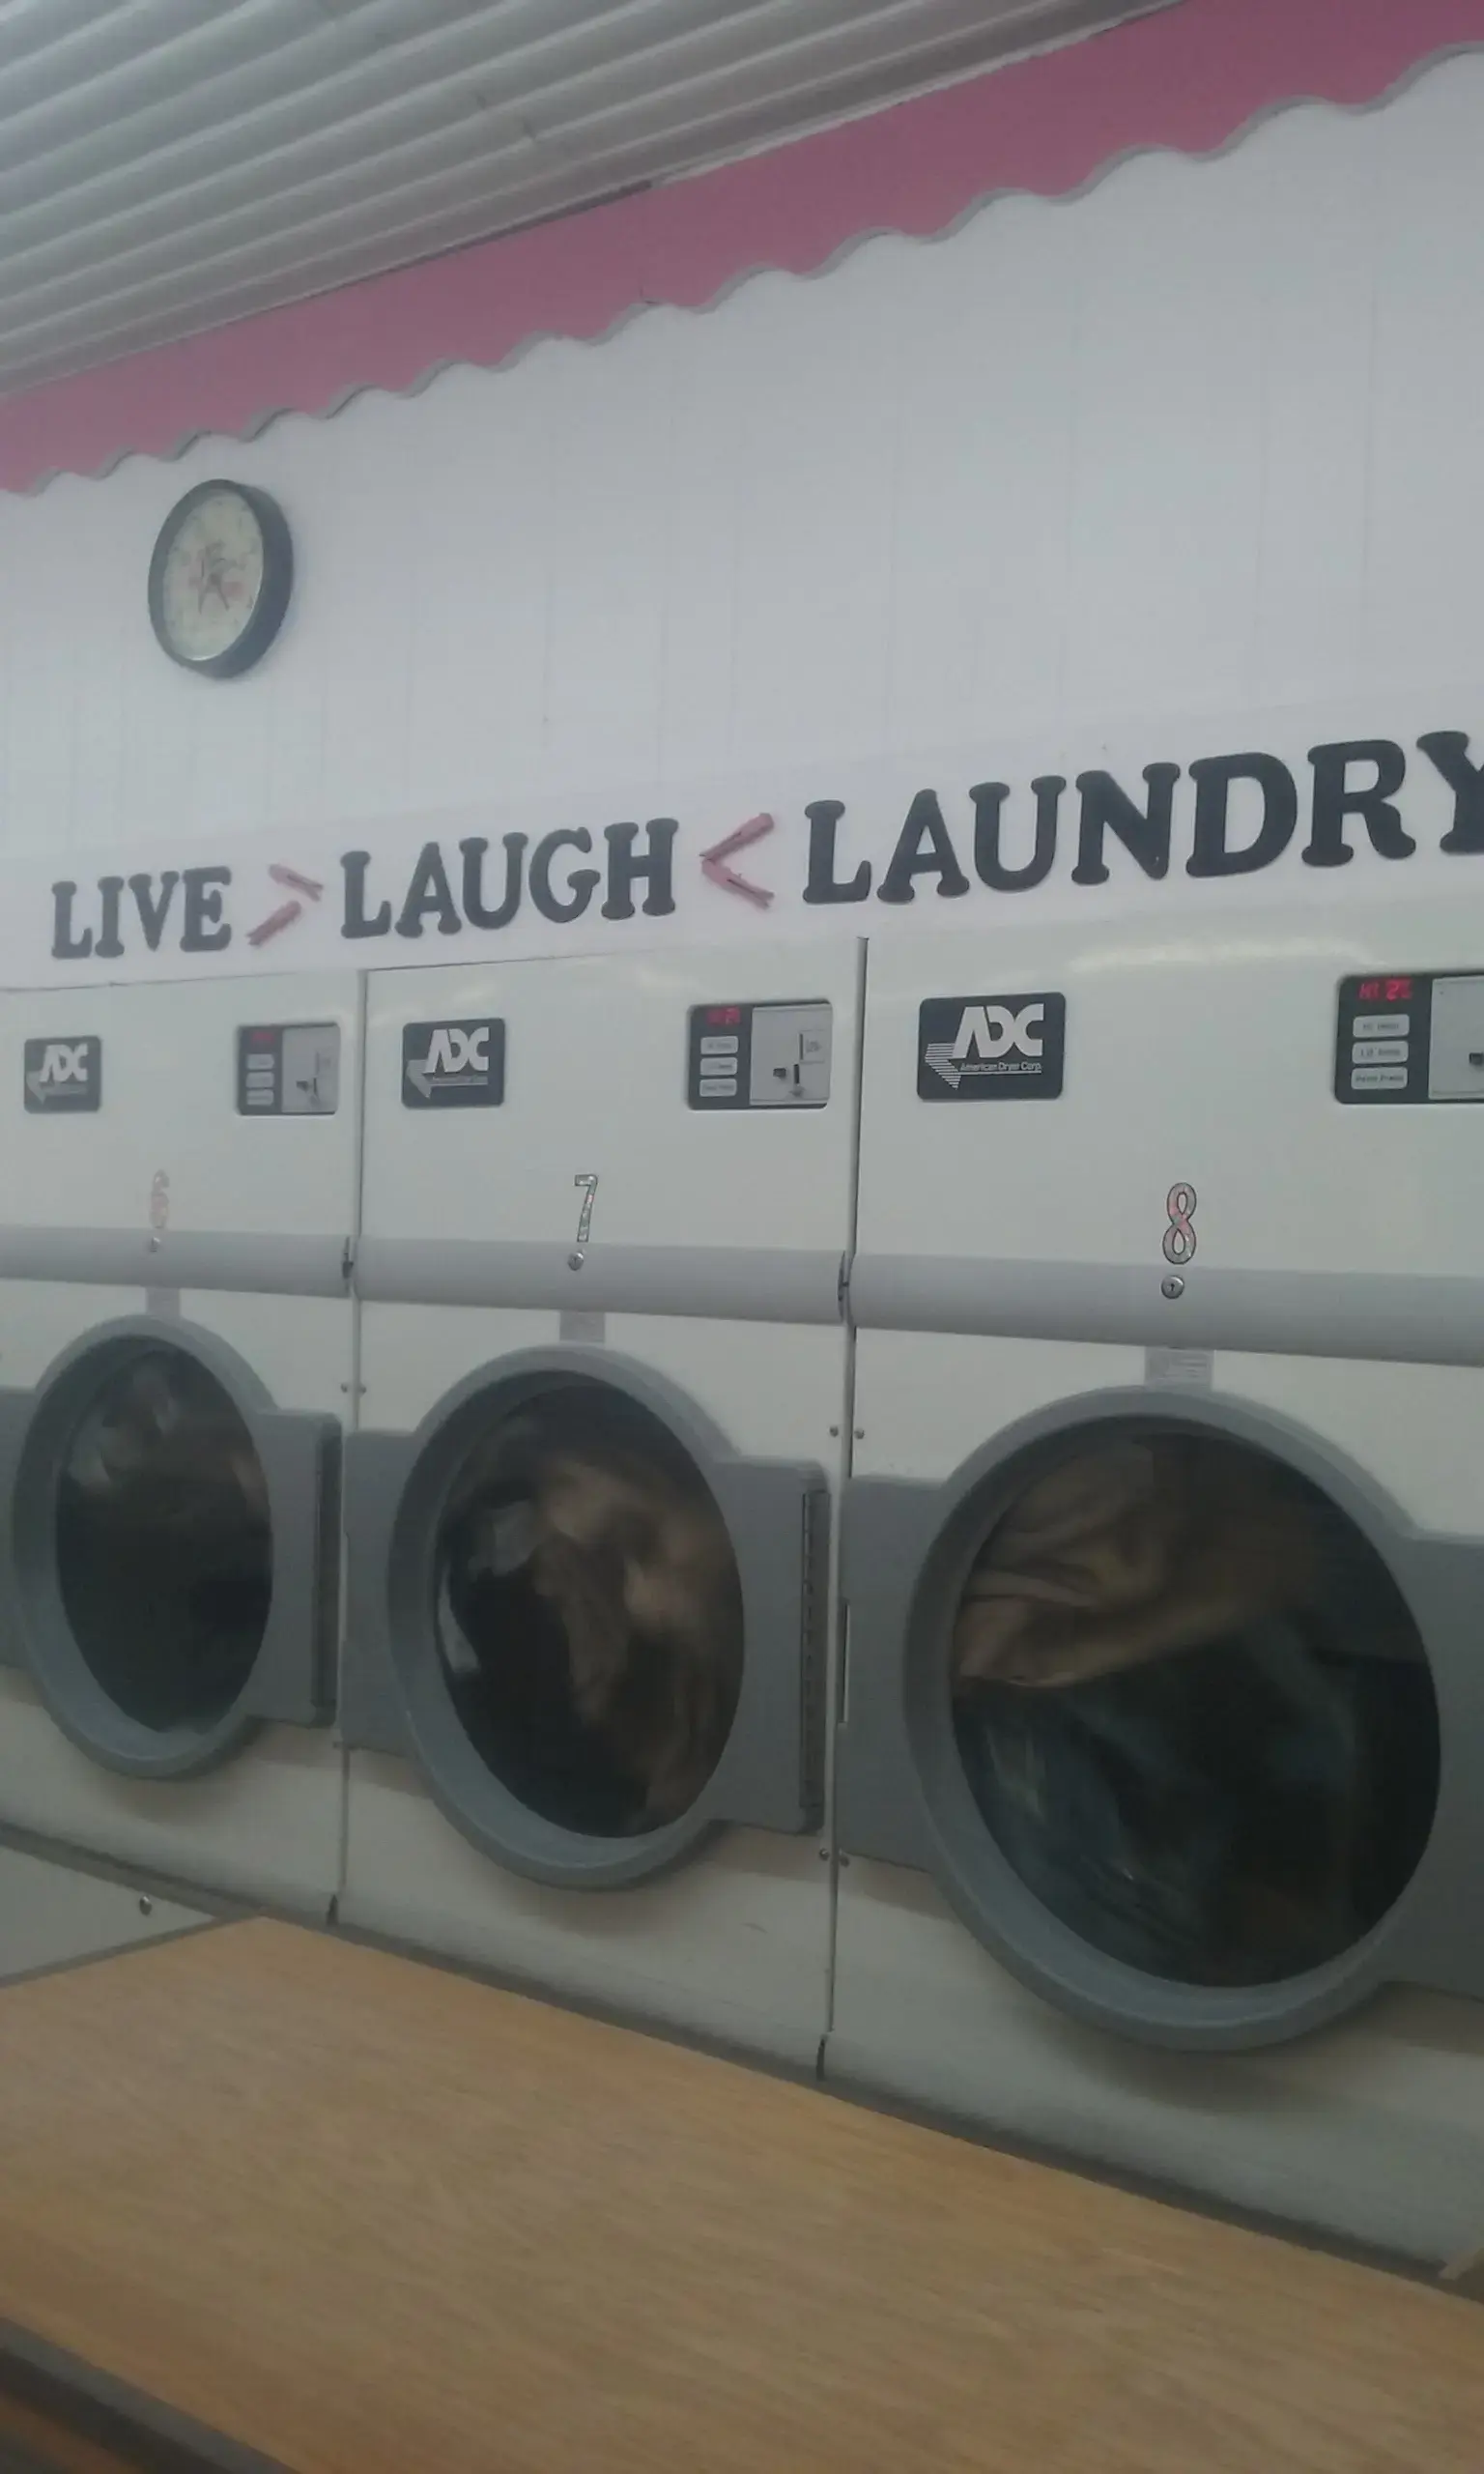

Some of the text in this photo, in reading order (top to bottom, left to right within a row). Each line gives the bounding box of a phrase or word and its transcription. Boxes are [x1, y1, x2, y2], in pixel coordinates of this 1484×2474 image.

[51, 731, 1484, 959] LIVE LAUGH LAUNDRY
[423, 1027, 490, 1073] ADC
[952, 1003, 1043, 1059] ADC
[40, 1044, 88, 1082] ADC
[574, 1174, 598, 1243] 7
[1162, 1182, 1197, 1264] 8
